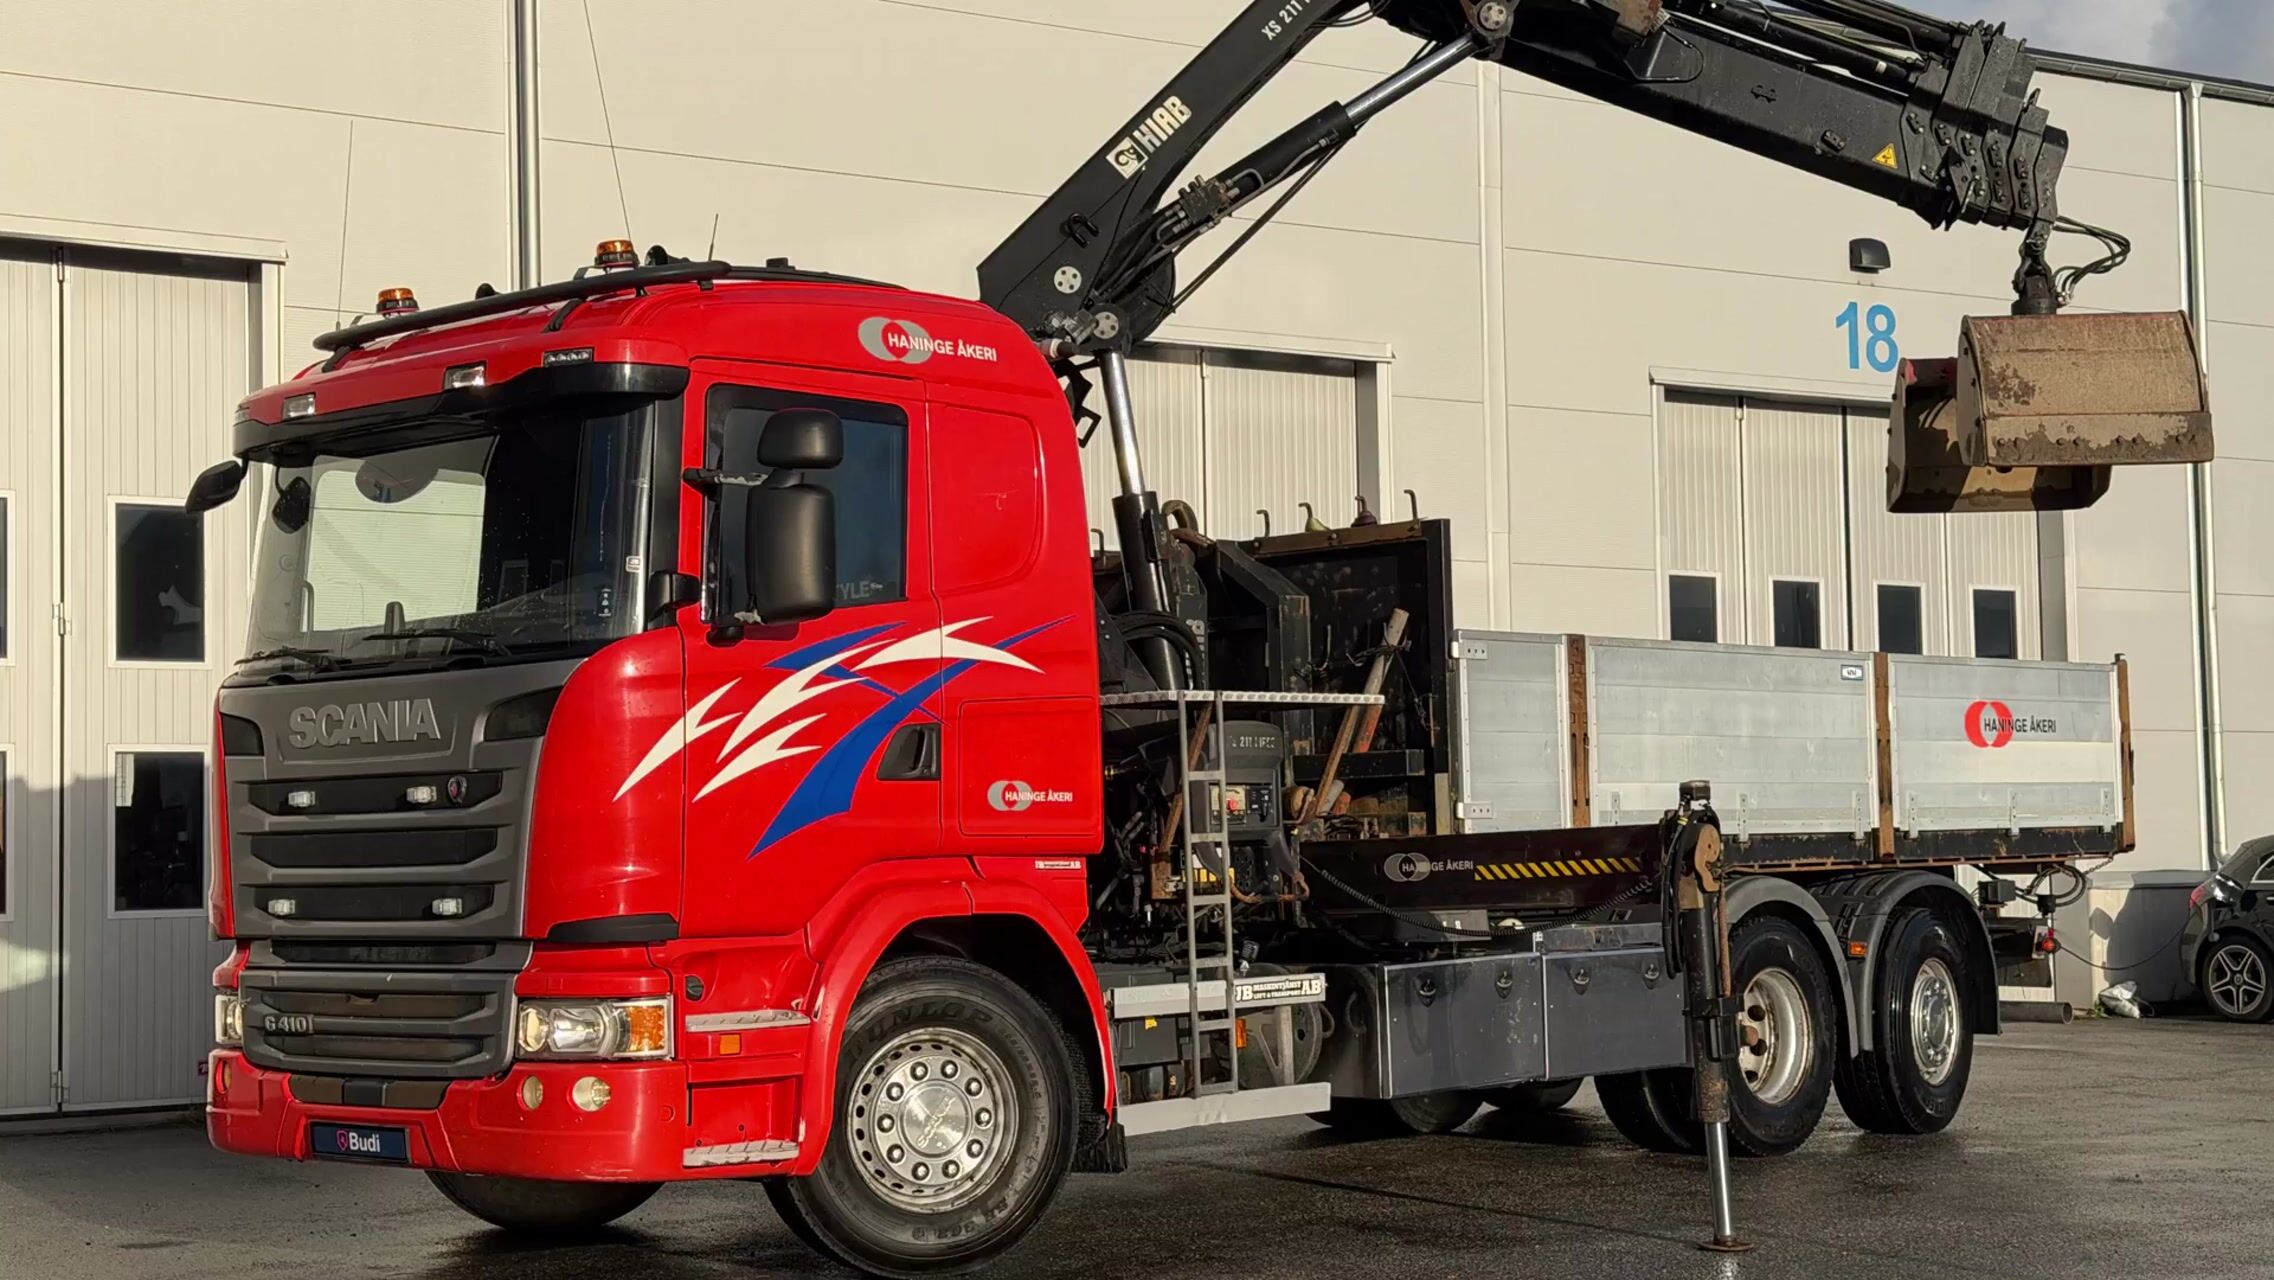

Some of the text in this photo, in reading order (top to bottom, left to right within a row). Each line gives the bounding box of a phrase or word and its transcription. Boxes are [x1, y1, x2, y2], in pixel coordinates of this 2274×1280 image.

[1261, 0, 1304, 41] XS 211
[1132, 95, 1192, 154] HIAB
[887, 332, 998, 362] HANINGE ÅKERI
[1835, 301, 1899, 373] 18
[288, 698, 441, 749] SCANIA
[1983, 714, 2057, 733] HANINGE ÅKERI
[1004, 788, 1073, 802] HANINGE ÅKERI
[1401, 858, 1474, 873] HAGE ÅKERI
[1236, 985, 1253, 1001] JB
[1302, 980, 1321, 995] AB
[264, 1015, 307, 1032] G 410
[348, 1132, 381, 1153] Budi
